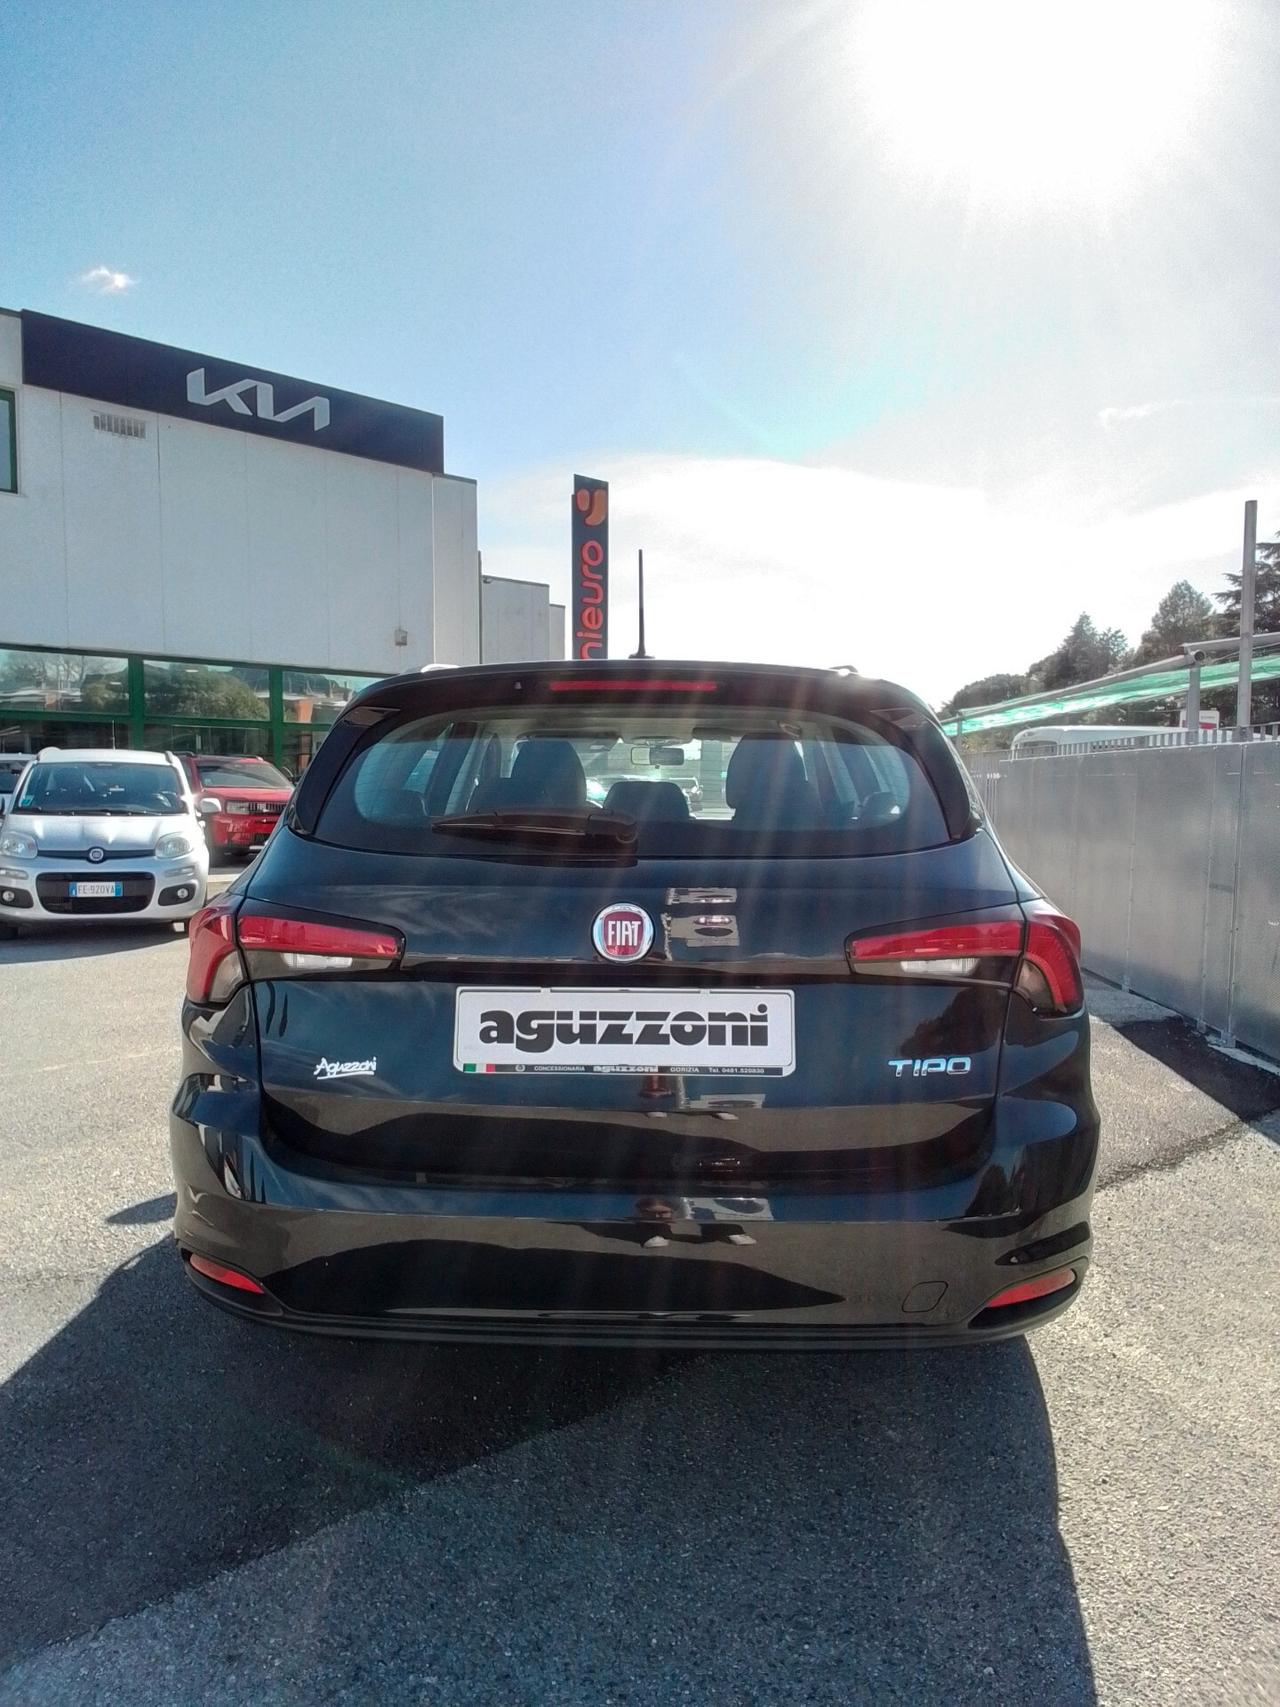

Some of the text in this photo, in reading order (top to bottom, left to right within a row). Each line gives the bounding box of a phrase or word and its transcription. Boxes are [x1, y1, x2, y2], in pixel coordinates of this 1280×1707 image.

[607, 920, 641, 946] FIAT
[479, 1003, 768, 1053] aguzzoni
[888, 1057, 971, 1077] TIPO
